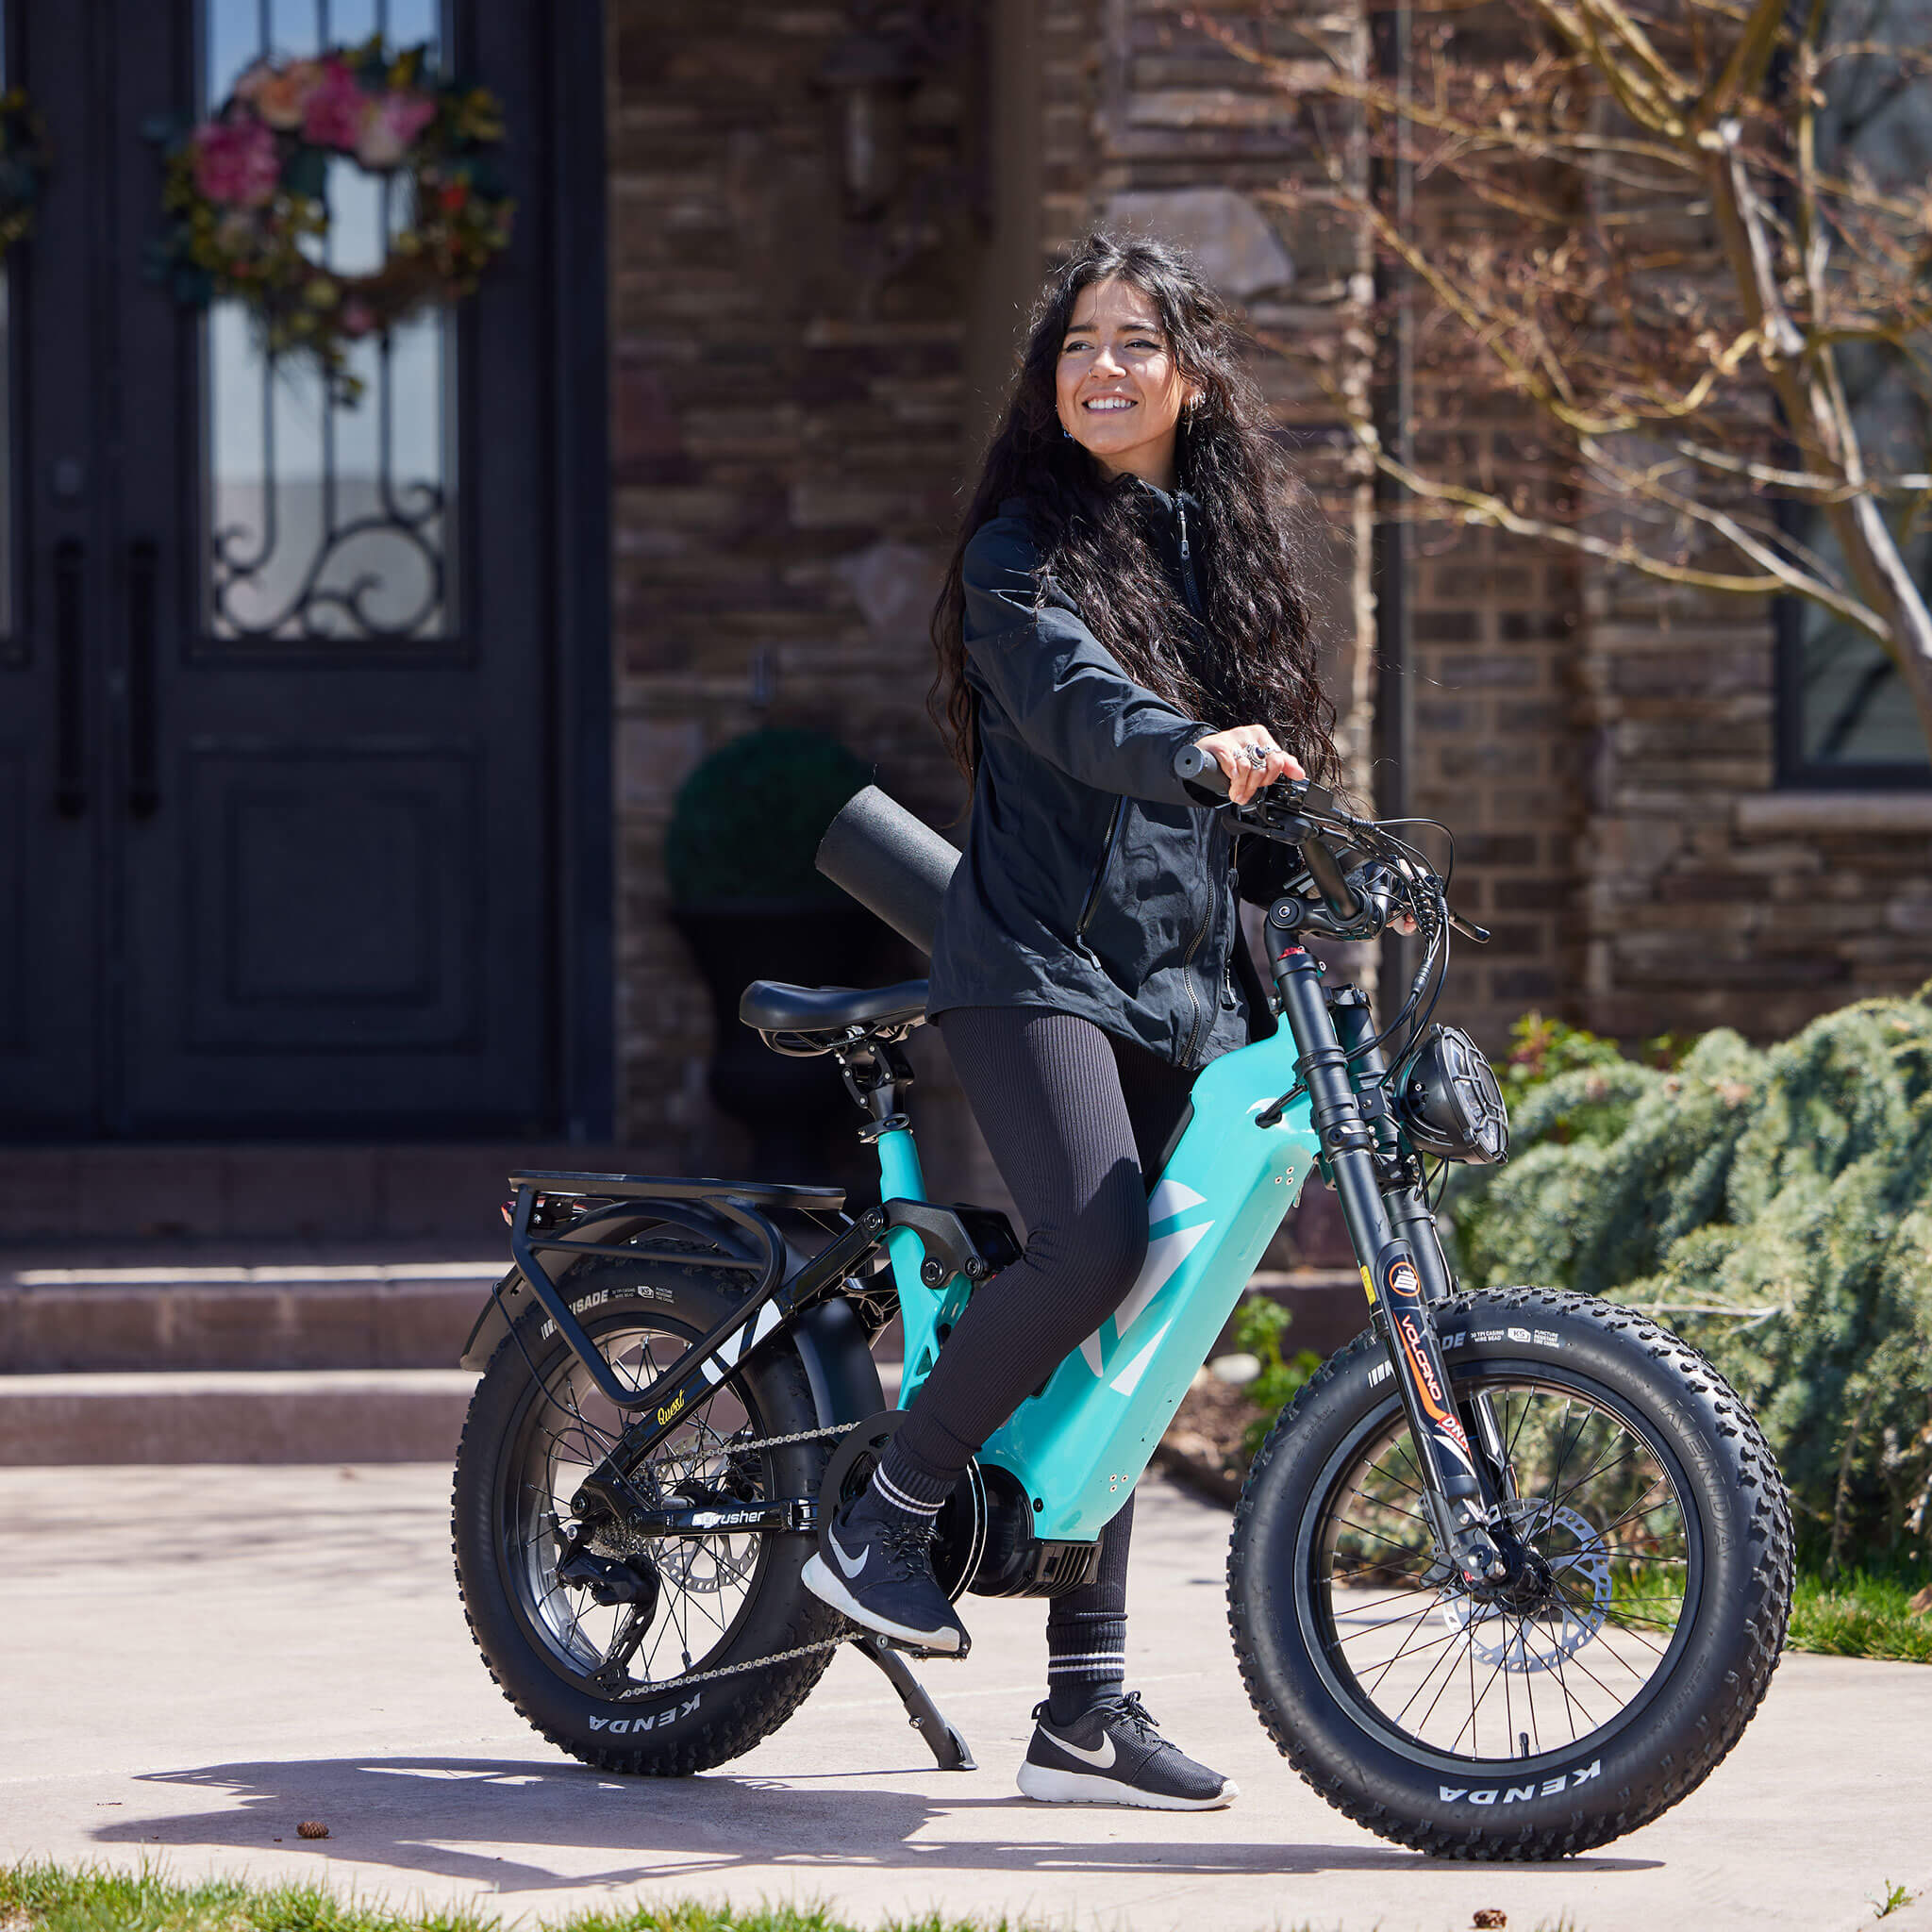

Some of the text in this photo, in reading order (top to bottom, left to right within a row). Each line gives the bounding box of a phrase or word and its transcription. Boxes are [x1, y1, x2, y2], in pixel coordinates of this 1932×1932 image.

[1401, 1314, 1442, 1402] VOLCANO
[657, 1389, 685, 1426] Quest
[1658, 1397, 1737, 1557] KENDA
[589, 1692, 702, 1734] KENDA
[1440, 1759, 1601, 1805] KENDA
